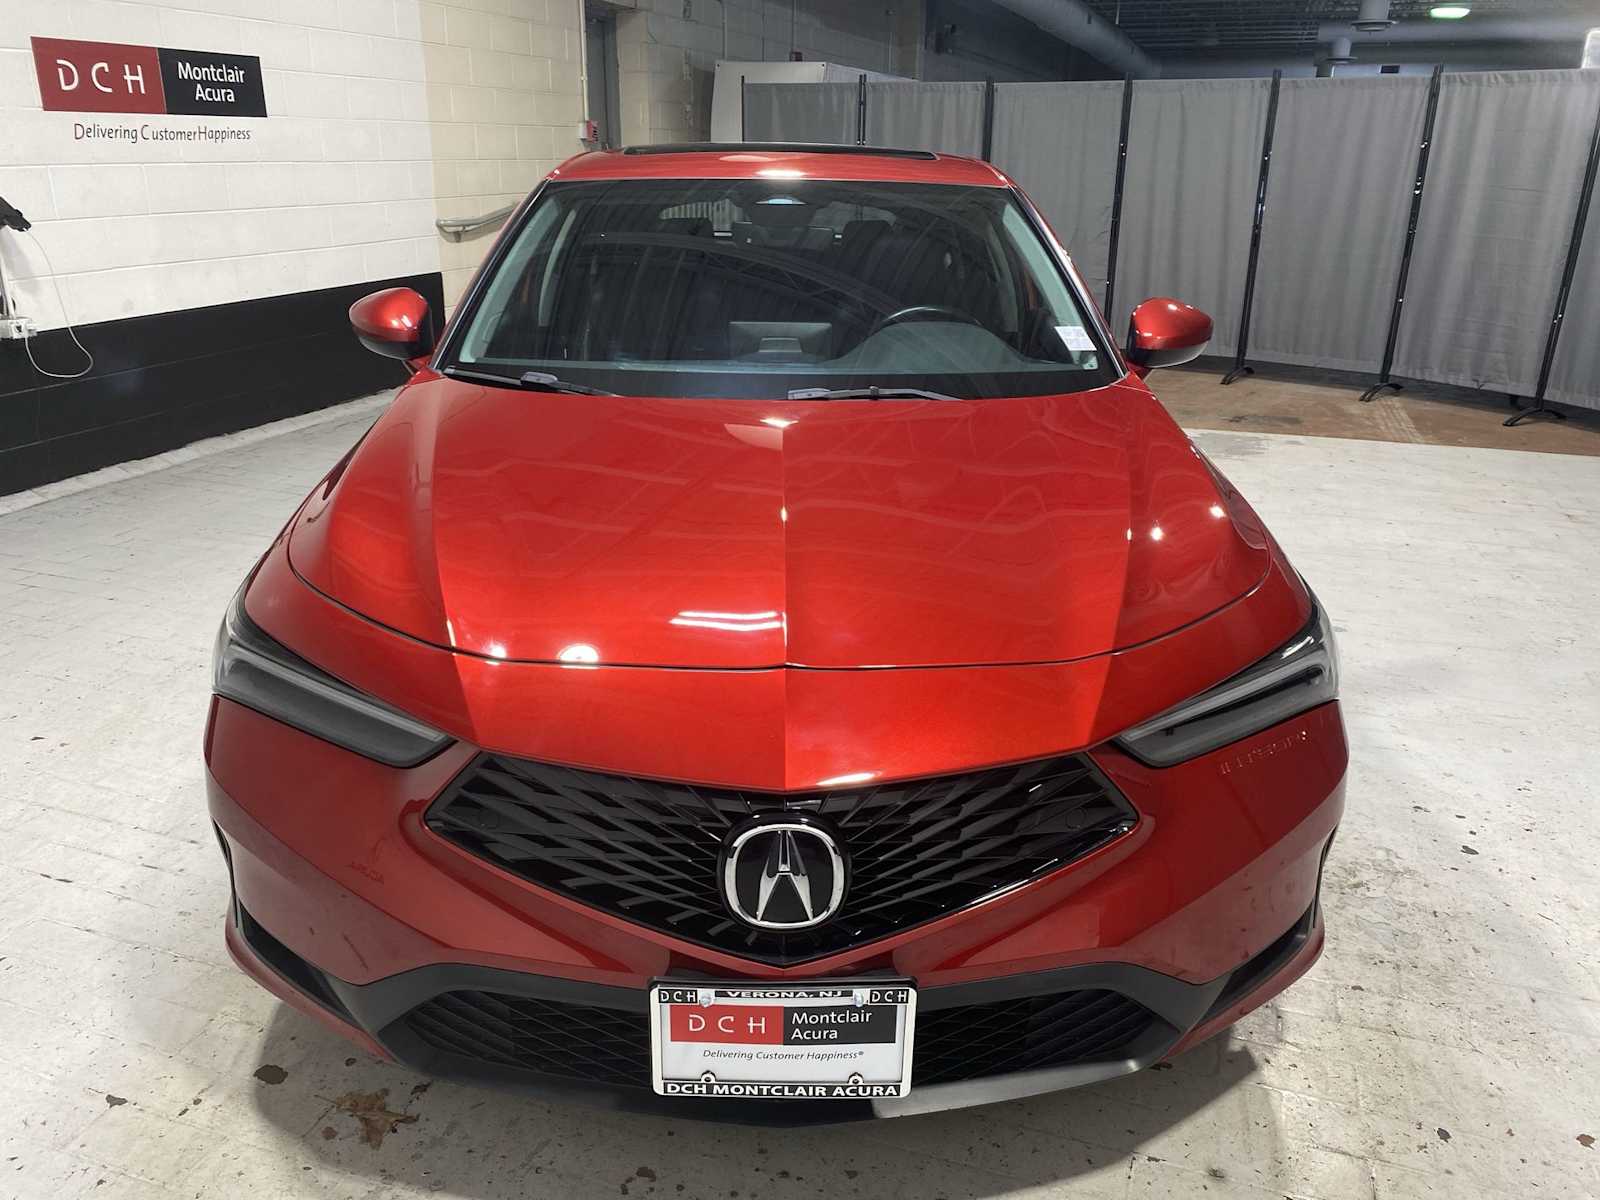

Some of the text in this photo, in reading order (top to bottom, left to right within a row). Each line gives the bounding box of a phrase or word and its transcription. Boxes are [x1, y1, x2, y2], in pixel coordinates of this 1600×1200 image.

[56, 59, 146, 94] DCH
[177, 61, 245, 84] Montclair
[195, 84, 236, 103] Acura
[73, 123, 138, 144] Delivering
[660, 990, 696, 1002] DCH
[819, 990, 842, 998] NJ
[871, 990, 907, 1002] DCH
[688, 1014, 766, 1034] DCH
[791, 1010, 872, 1025] Montclair
[791, 1028, 838, 1040] Acura
[703, 1049, 753, 1061] Delivering
[756, 1051, 804, 1060] Customer
[667, 1083, 898, 1097] DCH MONTCLAIR ACURA
